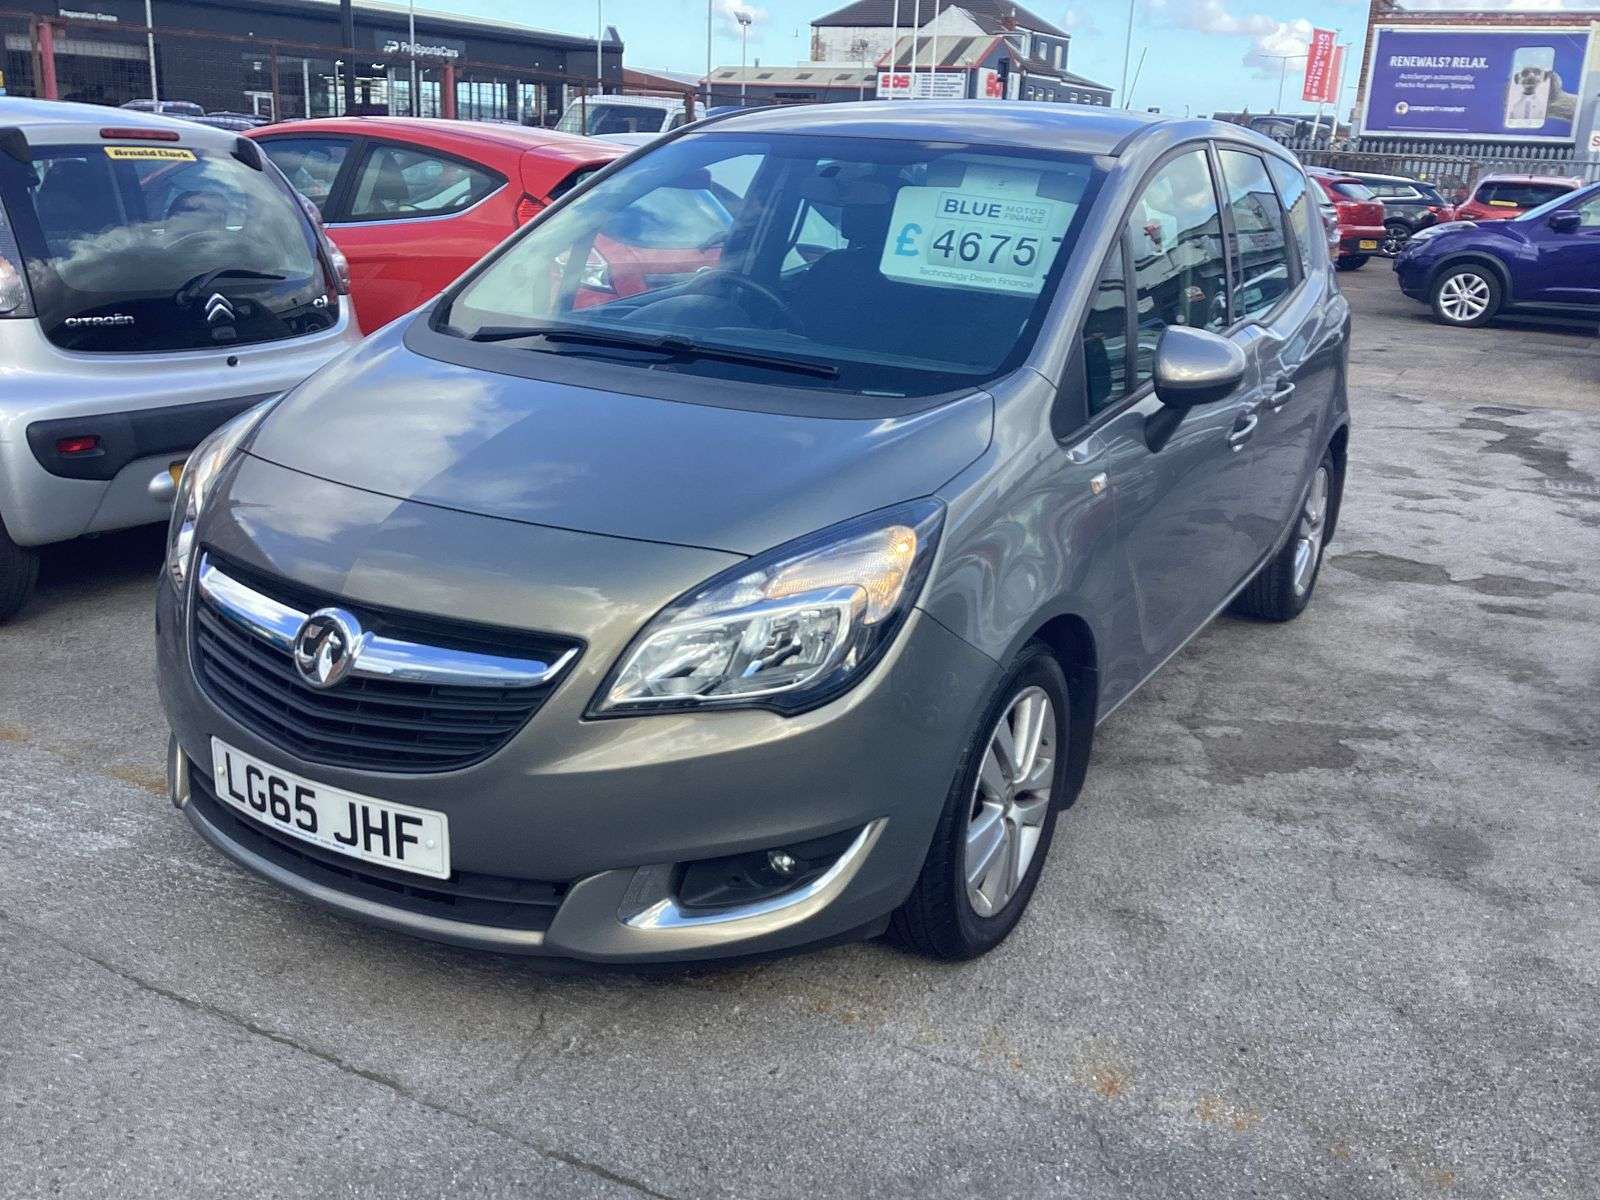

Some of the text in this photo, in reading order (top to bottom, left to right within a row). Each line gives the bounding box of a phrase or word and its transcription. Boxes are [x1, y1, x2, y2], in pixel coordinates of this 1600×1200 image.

[1390, 56, 1489, 69] RENEWALS? RELAX.
[943, 199, 1002, 218] BLUE
[1005, 206, 1046, 216] MOTOR
[1004, 213, 1044, 224] FINANCE
[895, 222, 1038, 267] £ 4675
[225, 752, 318, 833] LG65
[334, 802, 423, 860] JHF
